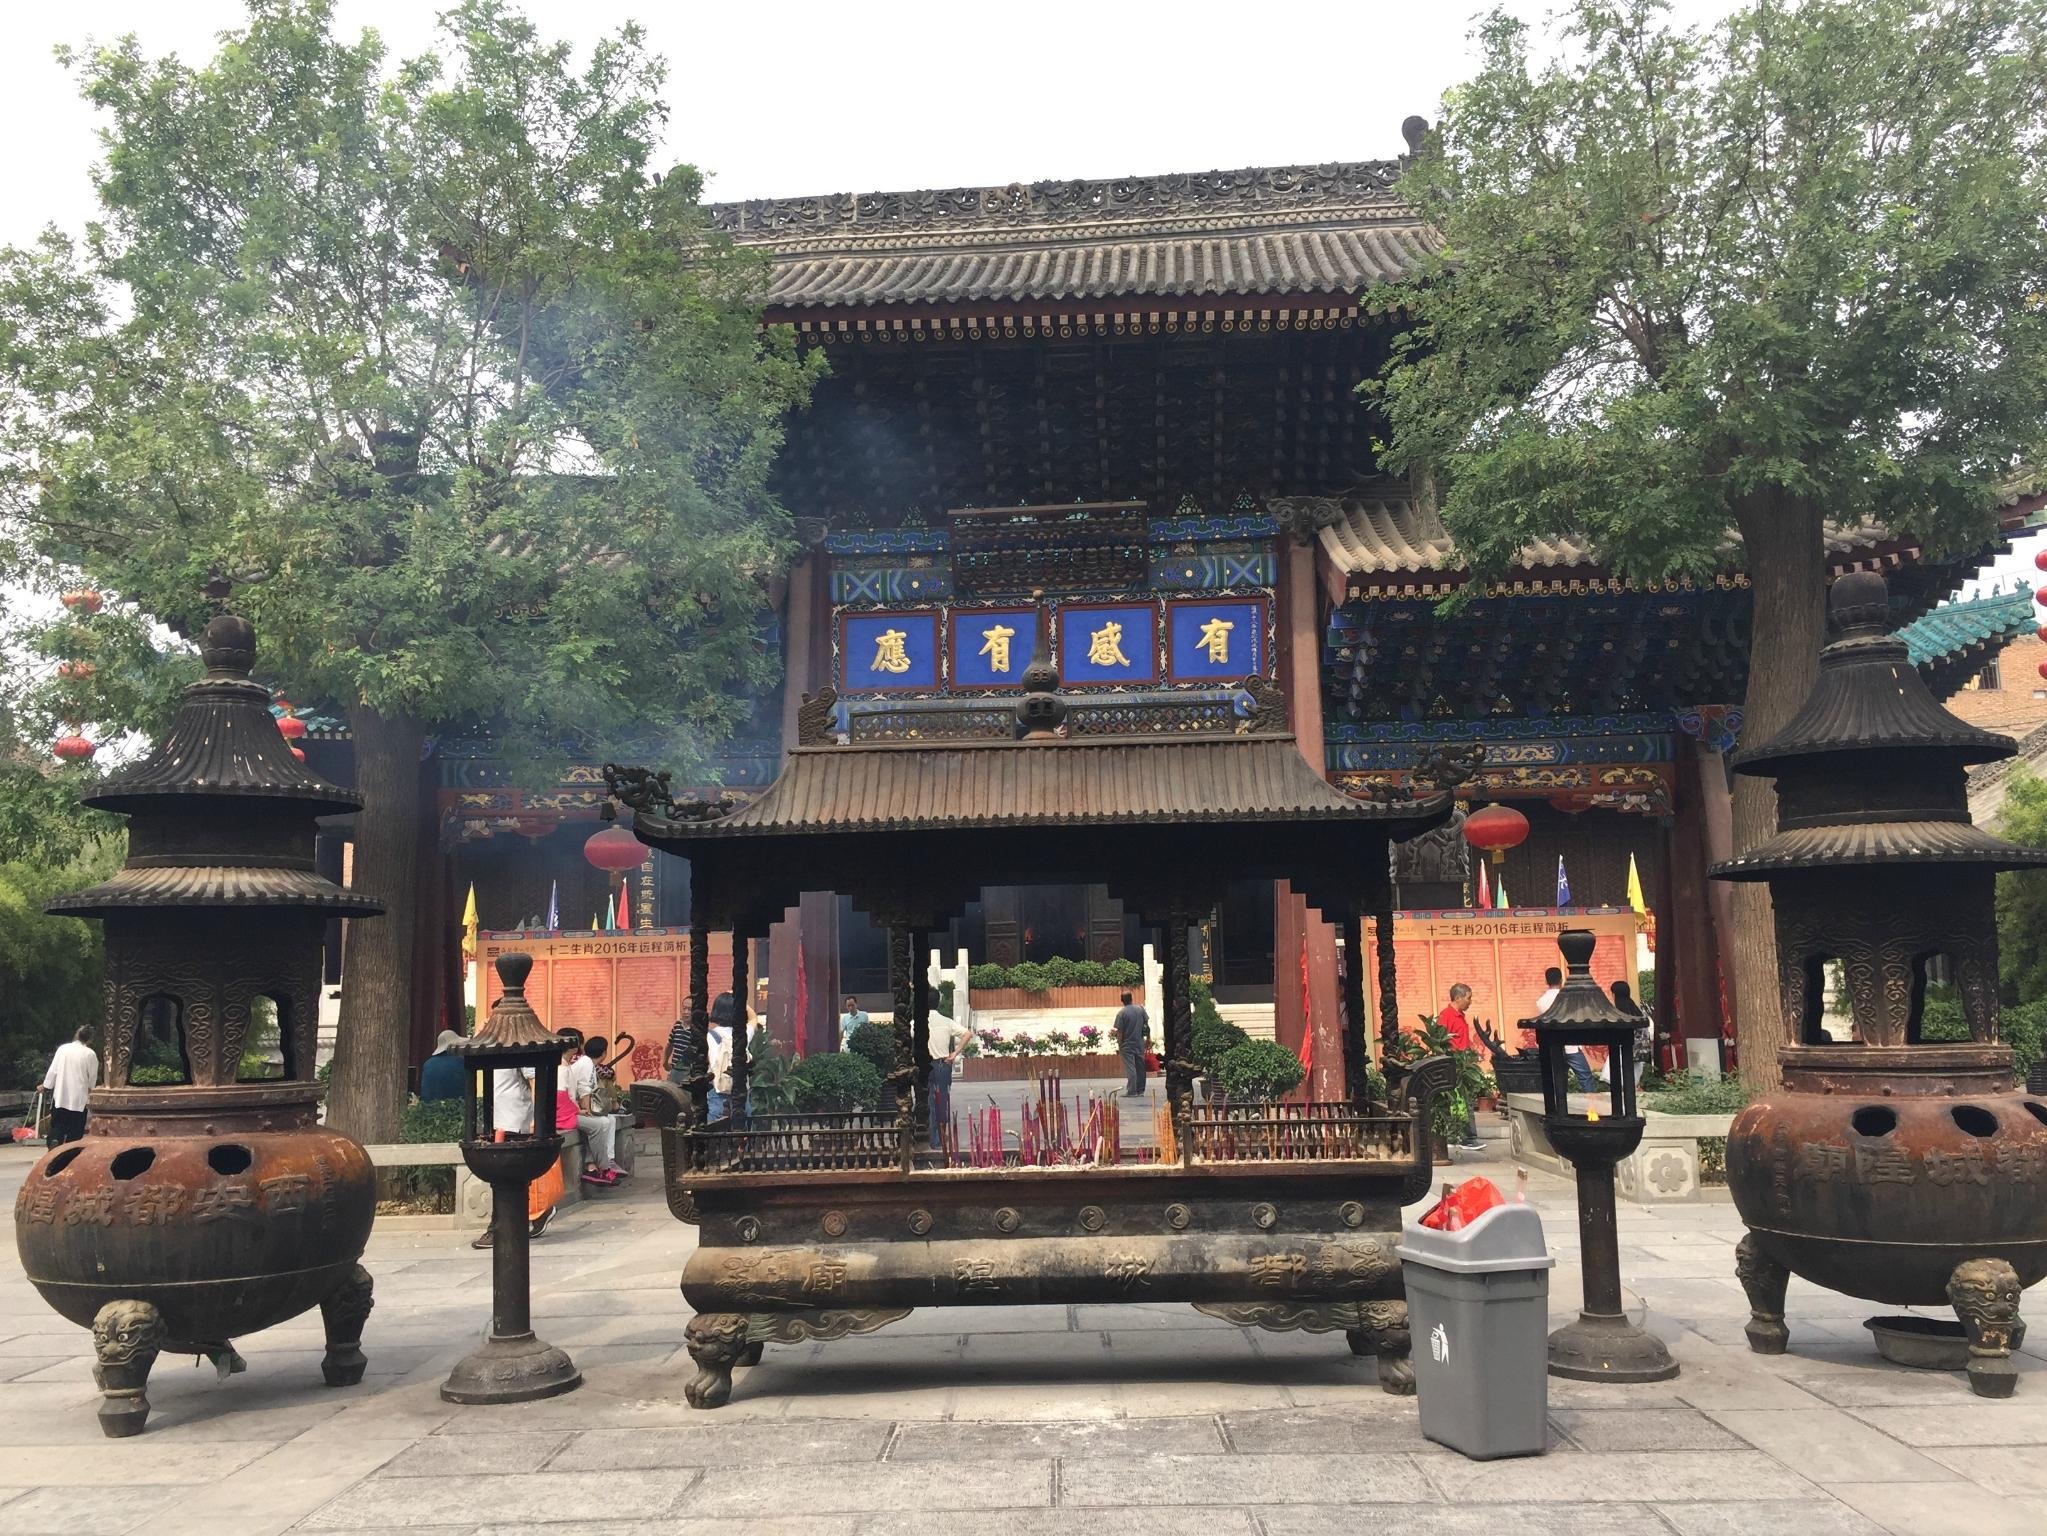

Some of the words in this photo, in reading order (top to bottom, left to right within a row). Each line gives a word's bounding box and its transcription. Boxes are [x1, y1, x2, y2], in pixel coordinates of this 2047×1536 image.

[978, 624, 1015, 673] 有
[1087, 621, 1131, 667] 感
[1194, 618, 1235, 664] 有
[546, 940, 688, 956] 十二生肖2016年运程简析
